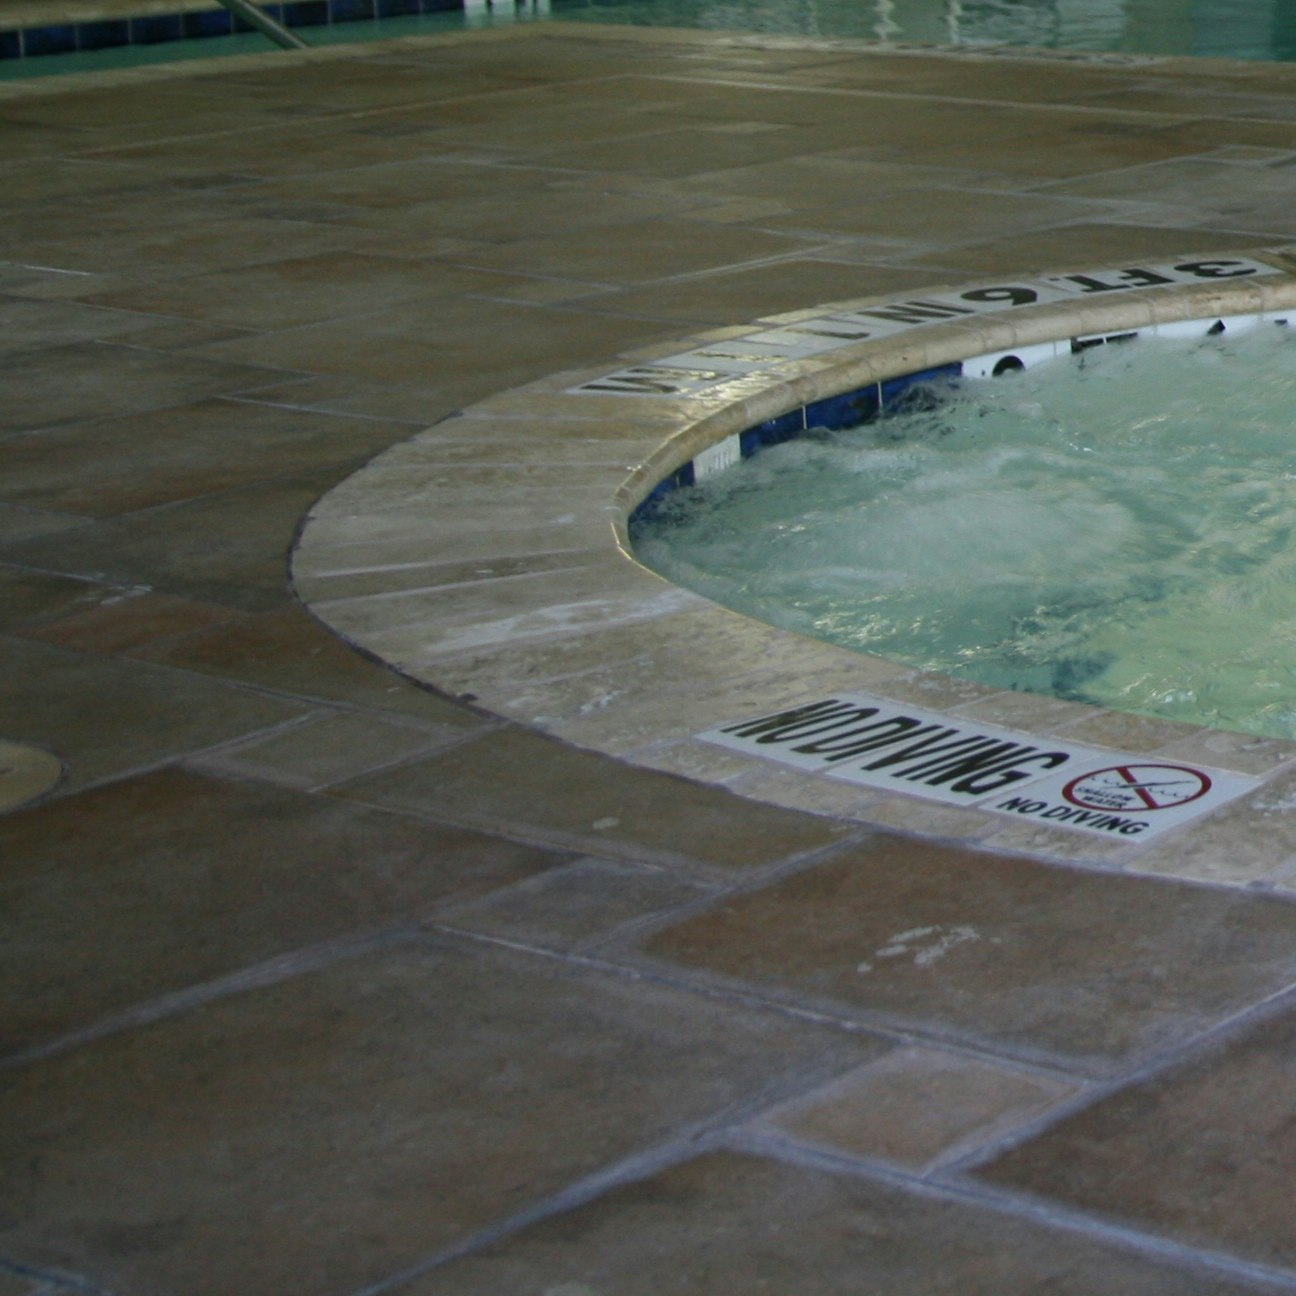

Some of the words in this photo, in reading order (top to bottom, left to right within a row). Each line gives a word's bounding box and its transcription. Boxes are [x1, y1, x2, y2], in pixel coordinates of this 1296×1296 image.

[719, 698, 880, 745] NO
[789, 717, 1071, 795] DIVING
[996, 796, 1049, 814] NO
[1039, 804, 1150, 835] DIVING
